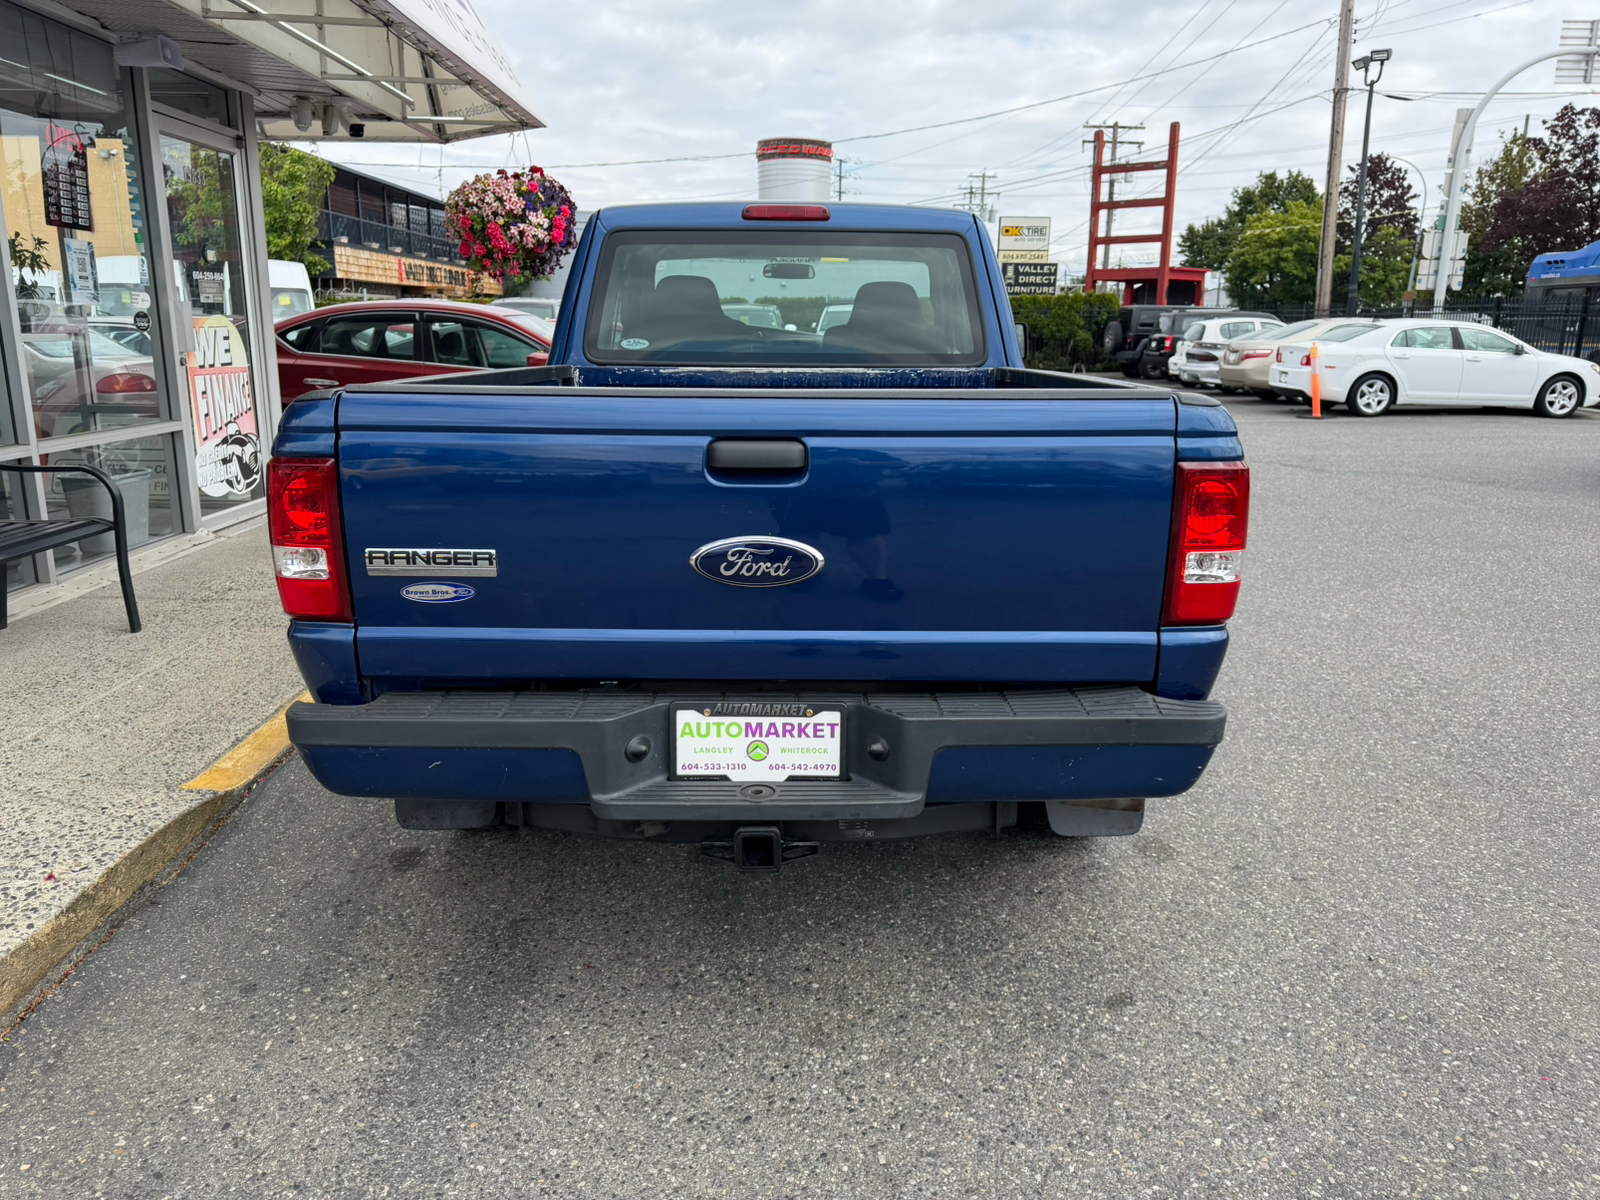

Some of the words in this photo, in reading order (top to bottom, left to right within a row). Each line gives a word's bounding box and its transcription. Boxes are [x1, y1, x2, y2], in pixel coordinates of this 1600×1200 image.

[45, 123, 84, 153] OPEN
[1002, 226, 1022, 236] OK
[1026, 227, 1045, 235] TIRE
[1018, 265, 1056, 273] VALLEY
[1018, 275, 1056, 284] DIRECT
[193, 326, 232, 368] WE
[193, 371, 252, 442] FINANCE
[368, 550, 494, 566] RANGER
[720, 547, 792, 576] Ford
[712, 703, 808, 716] AUTOMARKET
[679, 722, 839, 739] AUTOMARKET
[681, 763, 747, 771] 604-533-1310
[768, 763, 837, 771] 604-542-4970
